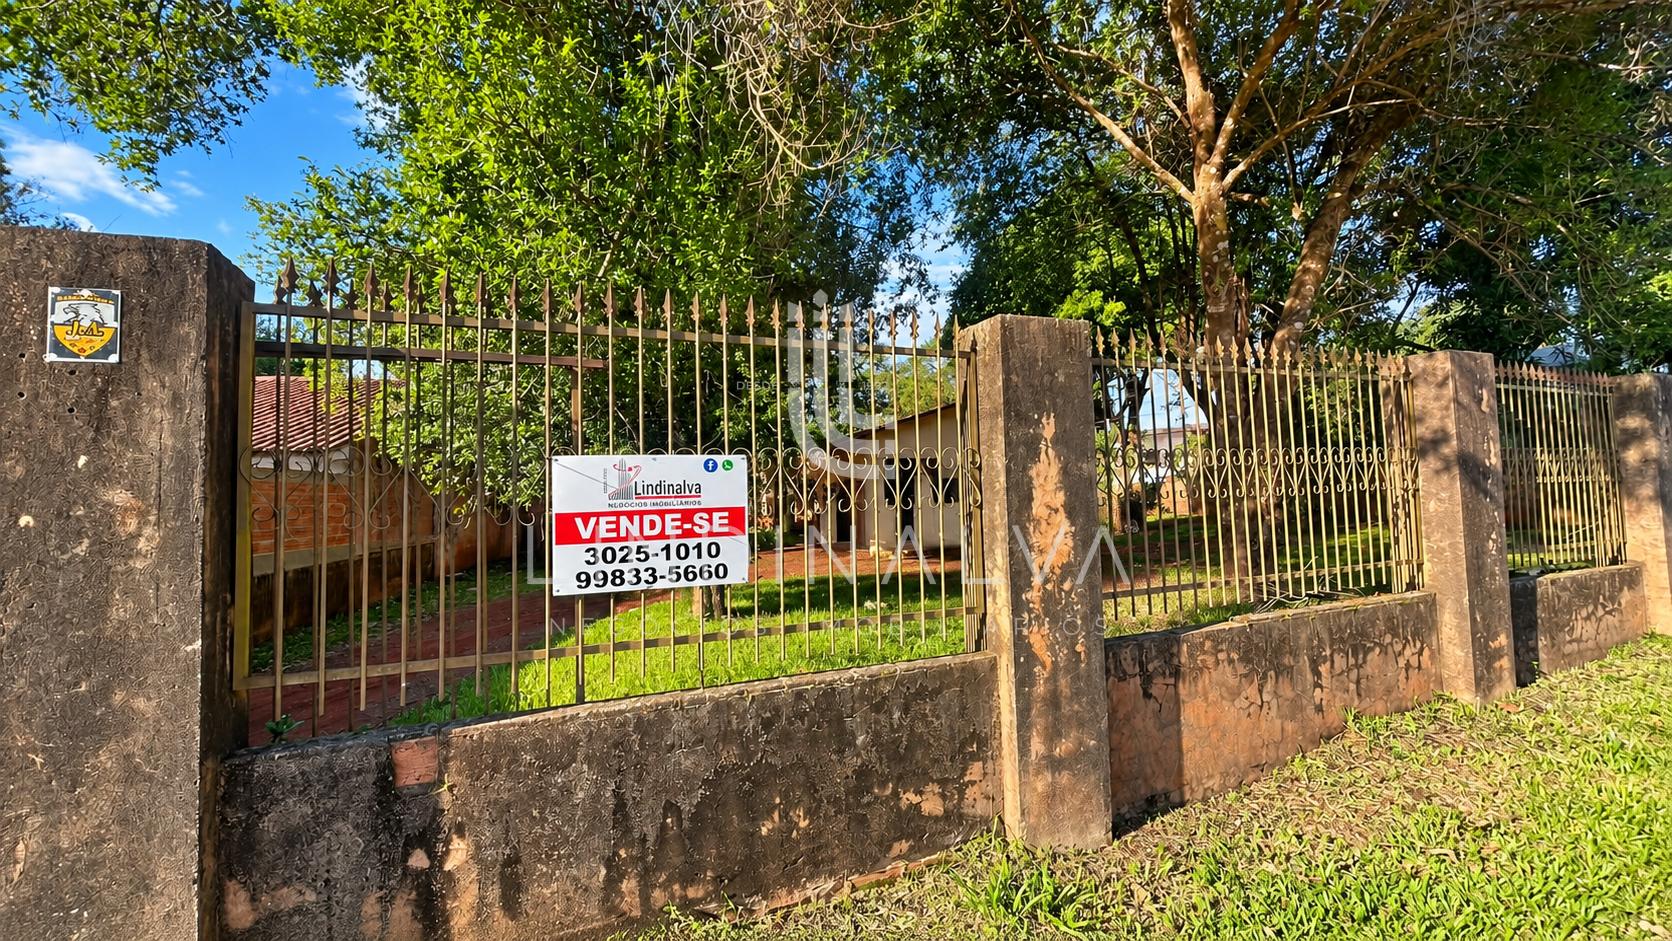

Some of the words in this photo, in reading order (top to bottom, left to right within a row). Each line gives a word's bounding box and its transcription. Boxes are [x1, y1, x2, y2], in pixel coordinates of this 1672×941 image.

[635, 480, 702, 496] Lindinalva
[575, 512, 729, 539] VENDE-SE
[584, 542, 720, 566] 3025-1010
[576, 563, 728, 590] 99833-5660
